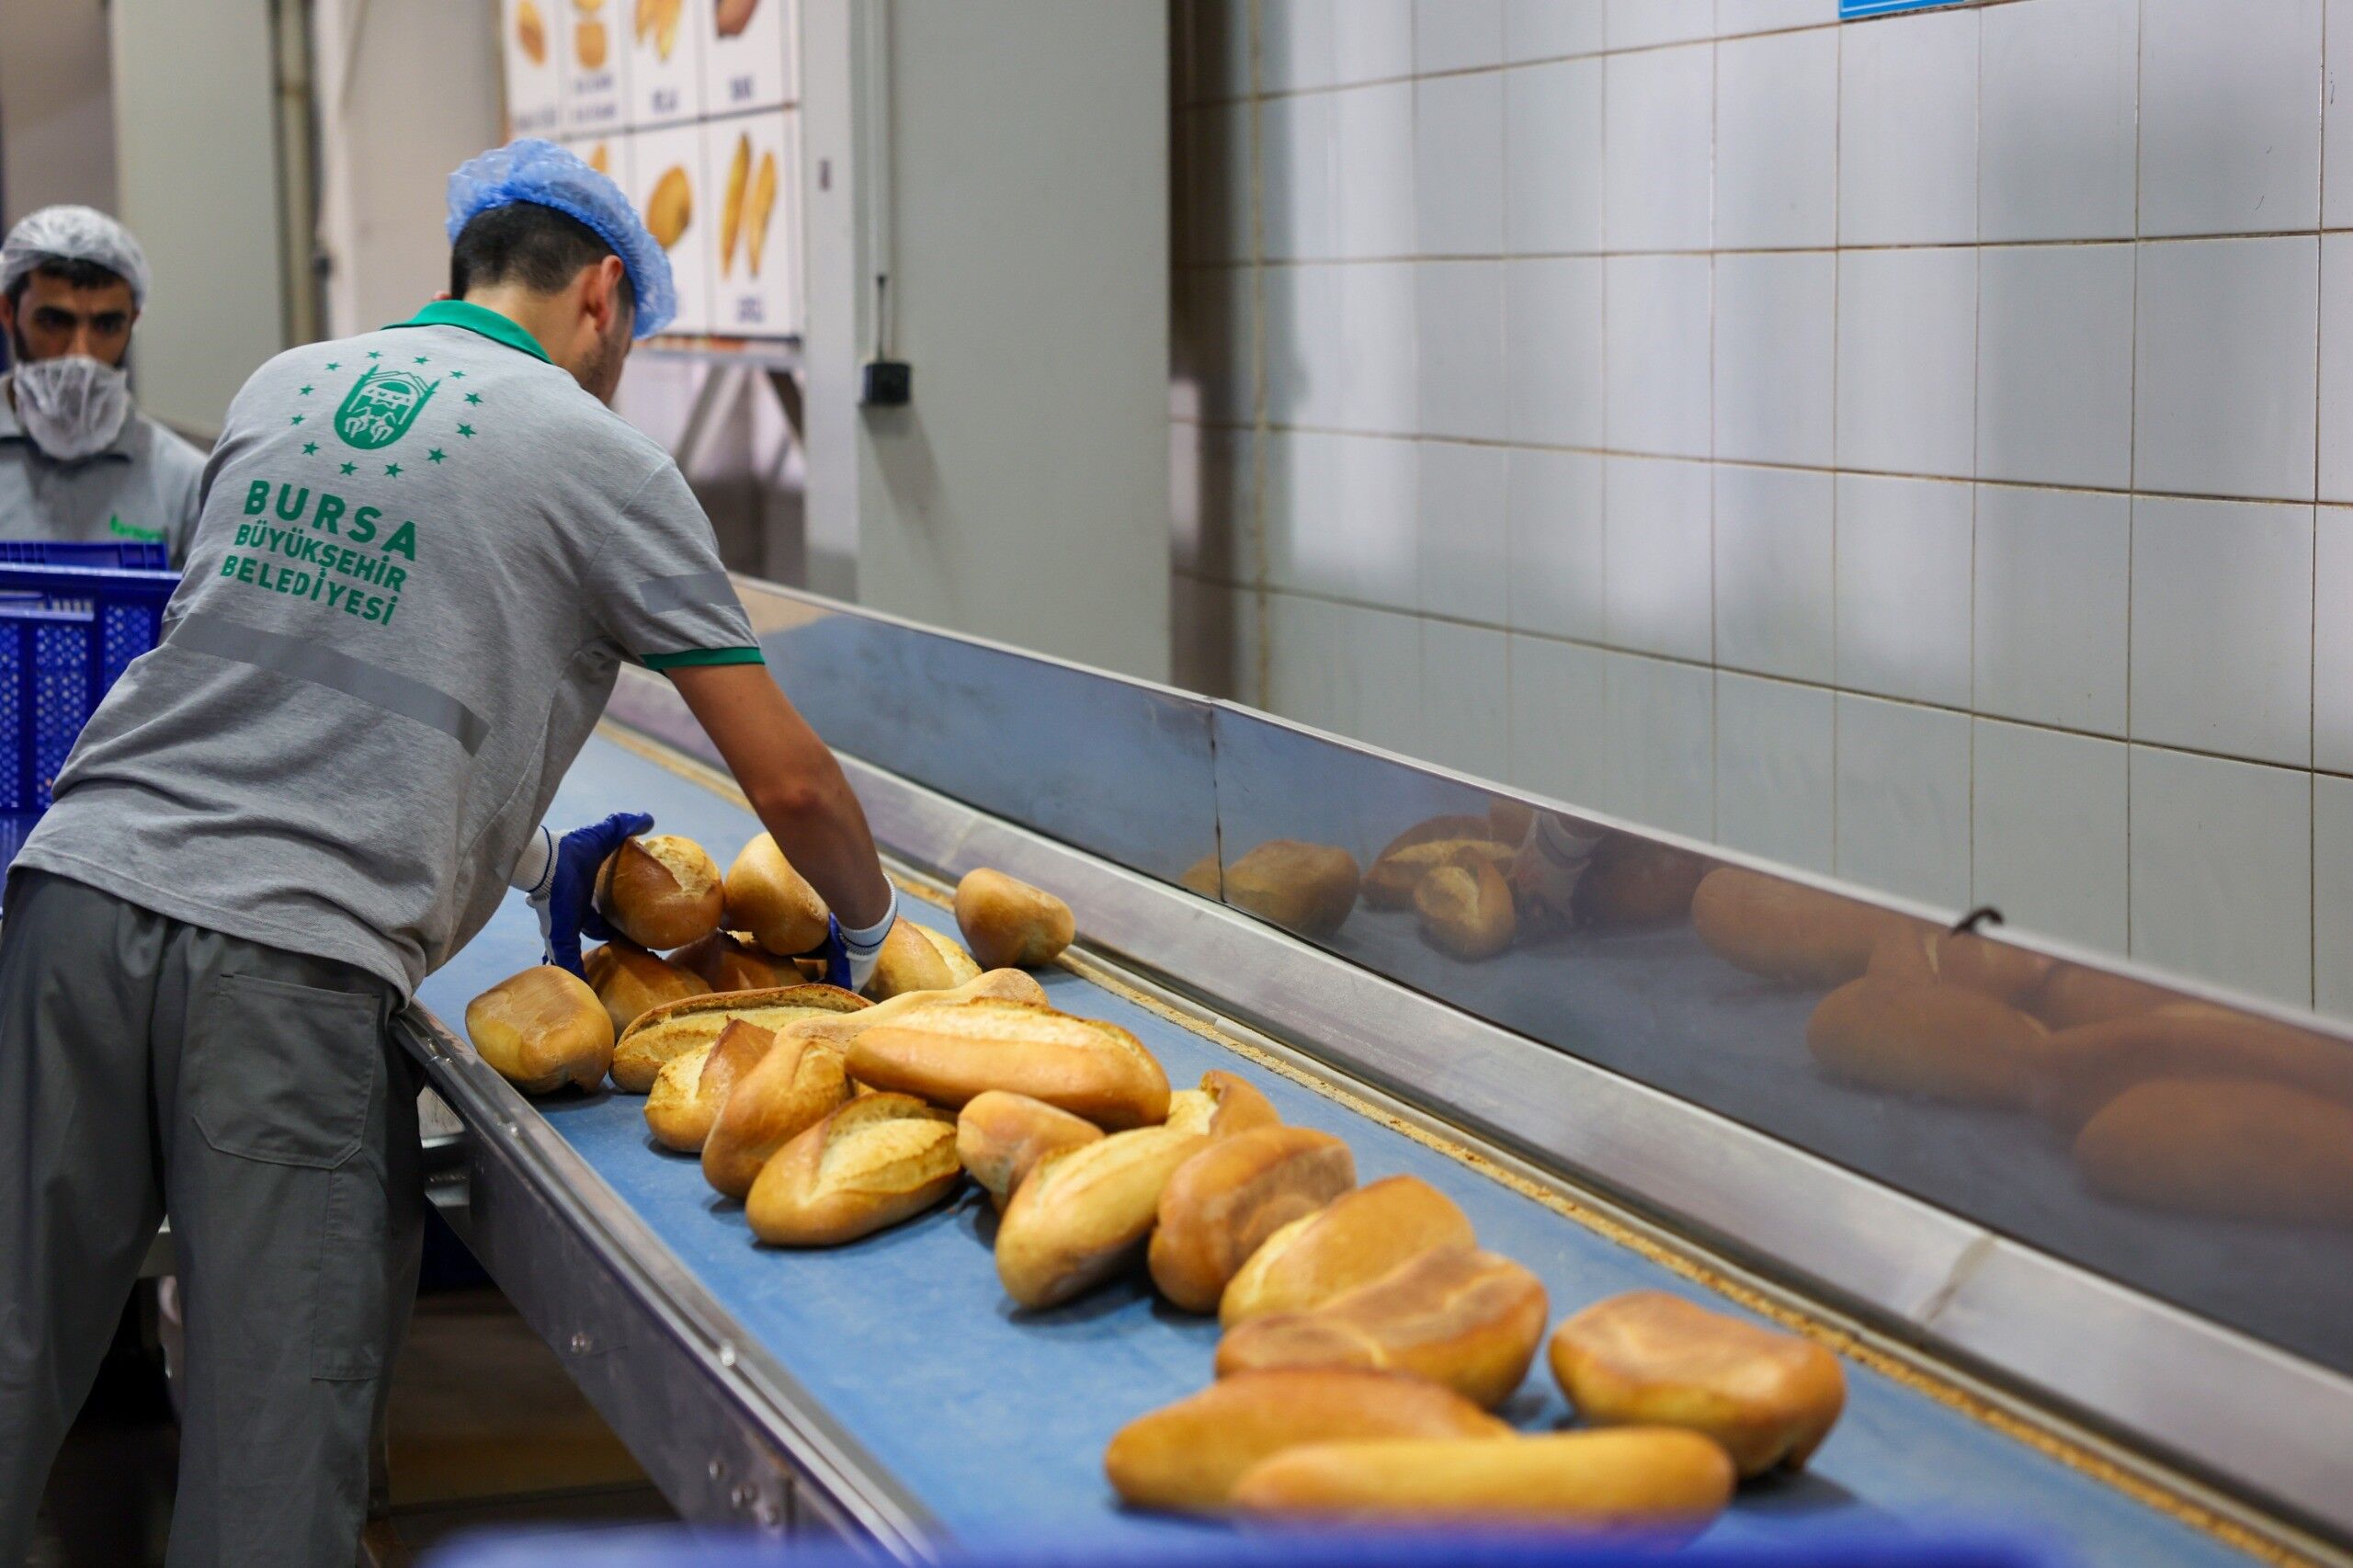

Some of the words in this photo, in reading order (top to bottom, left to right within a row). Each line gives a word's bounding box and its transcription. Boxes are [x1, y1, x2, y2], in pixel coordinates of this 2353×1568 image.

[234, 519, 408, 593] BÜYÜKŞEHİR
[244, 479, 416, 561] BURSA
[220, 554, 398, 625] BELEDİYESİ
